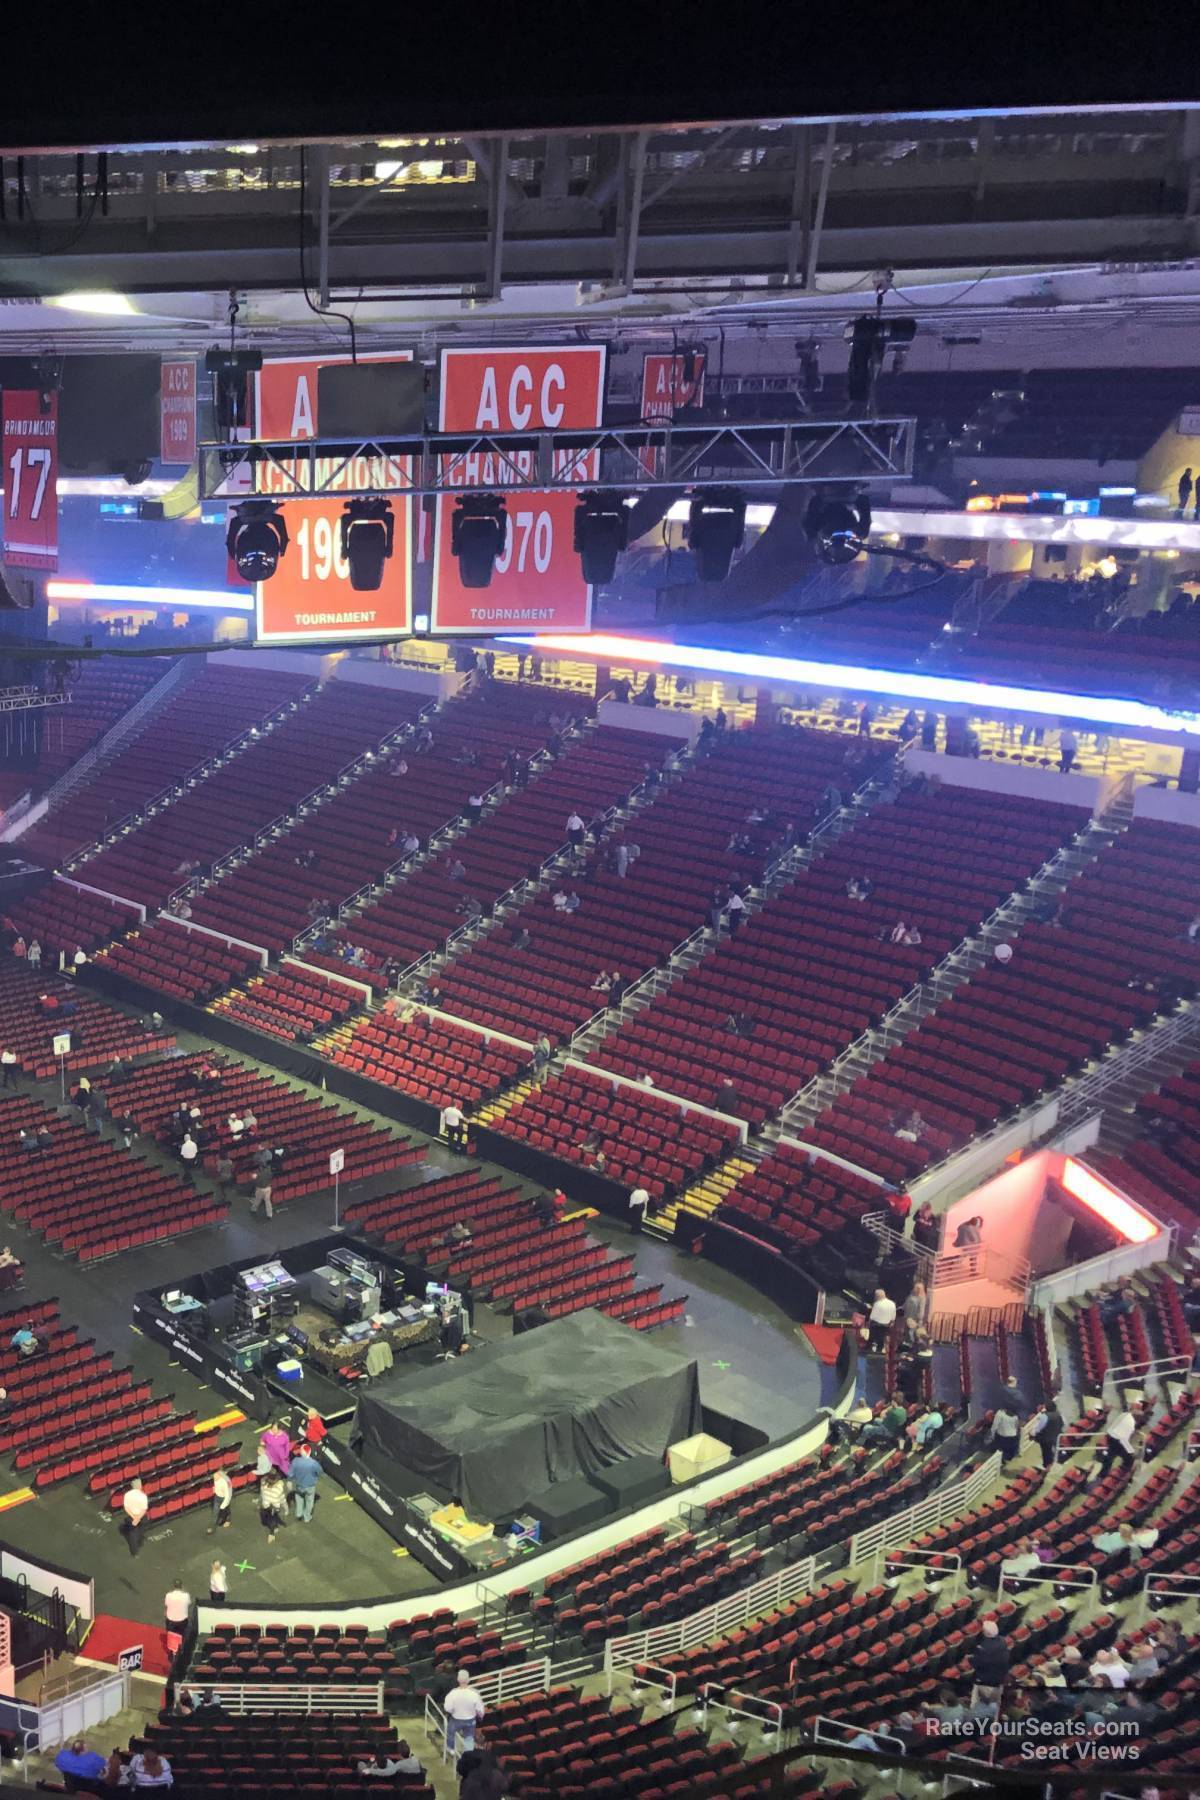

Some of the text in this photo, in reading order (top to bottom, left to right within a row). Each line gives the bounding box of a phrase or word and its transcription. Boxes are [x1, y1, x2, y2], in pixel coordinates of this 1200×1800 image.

[168, 367, 189, 391] ACC
[475, 363, 566, 430] ACC
[9, 447, 52, 520] 17
[494, 510, 553, 574] 970
[294, 610, 377, 626] TOURNAMENT
[469, 608, 556, 620] TOURNAMENT
[119, 1651, 142, 1671] BAR
